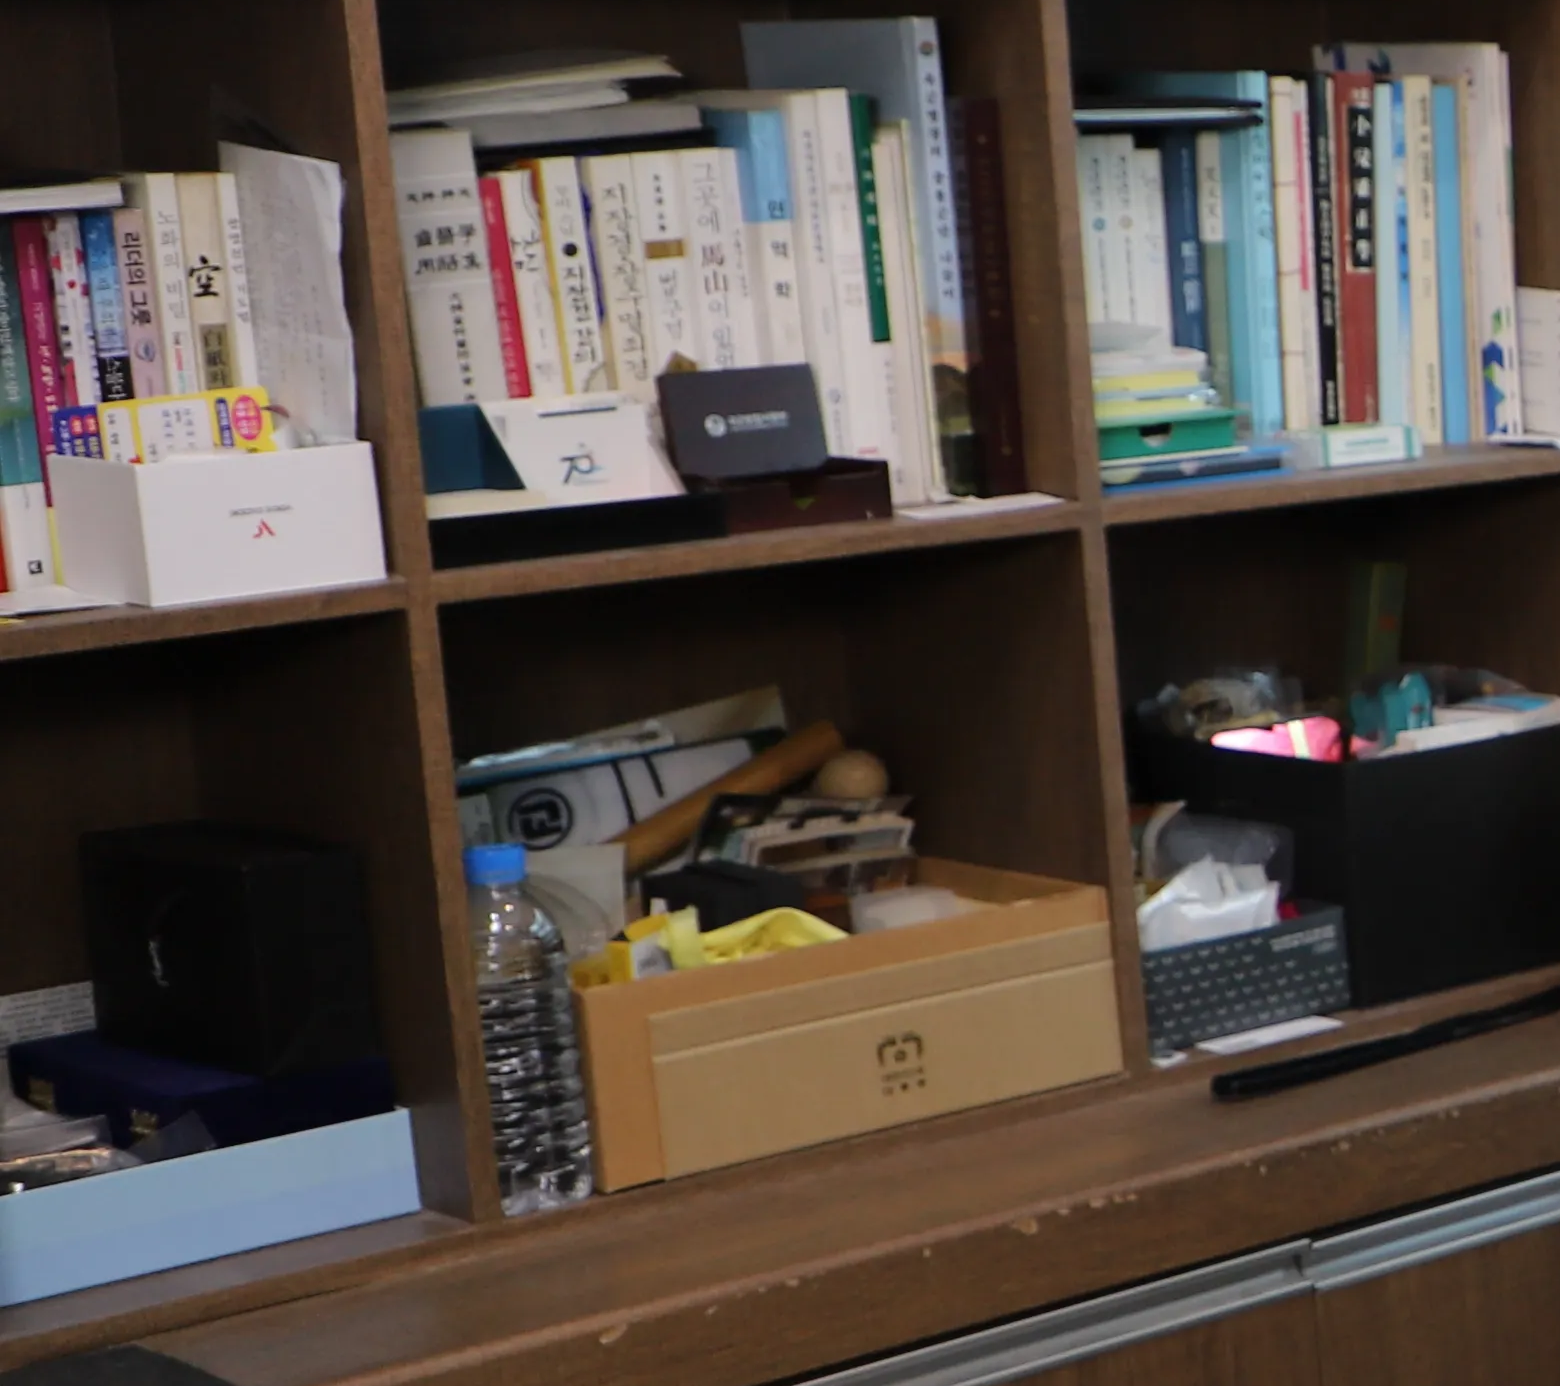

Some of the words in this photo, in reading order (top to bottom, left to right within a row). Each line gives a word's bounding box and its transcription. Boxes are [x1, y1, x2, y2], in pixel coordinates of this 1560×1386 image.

[122, 232, 149, 285] 리더의
[188, 254, 223, 298] 空
[129, 289, 153, 327] 그릇
